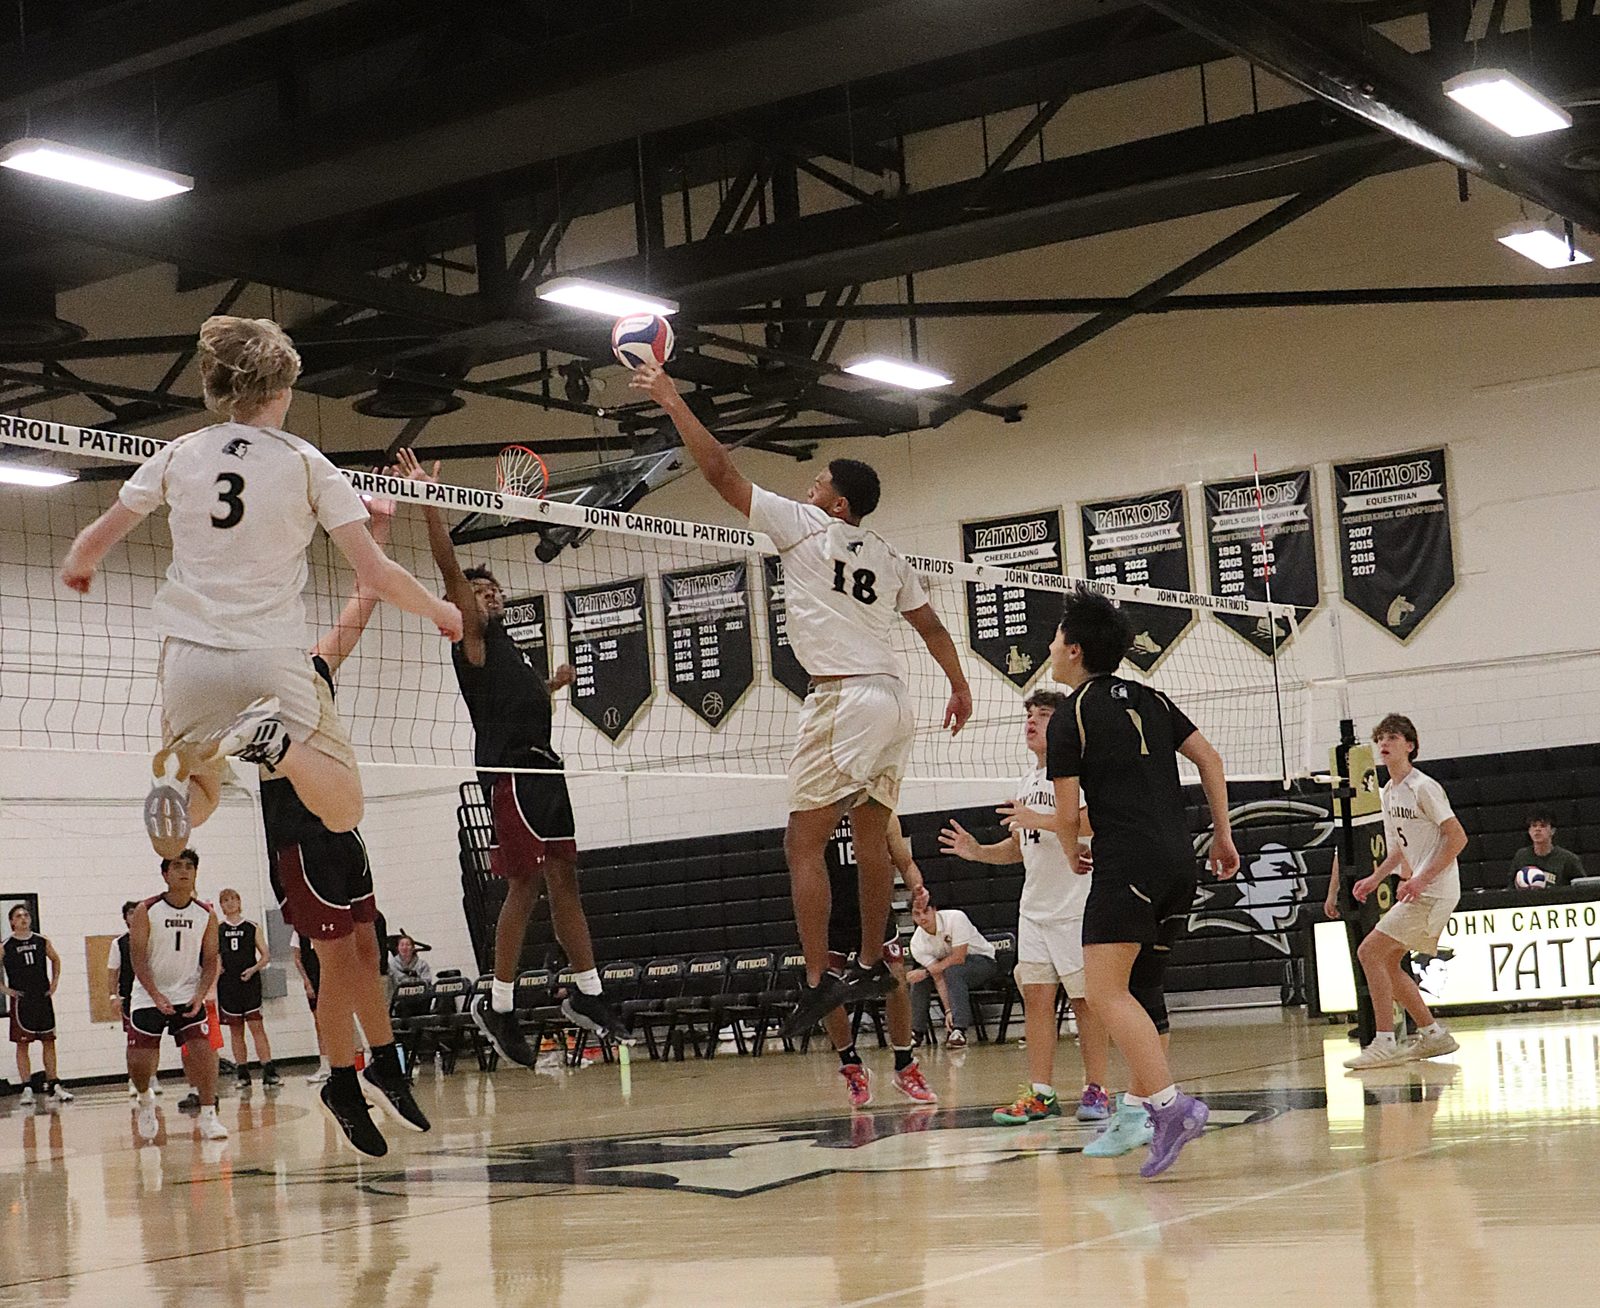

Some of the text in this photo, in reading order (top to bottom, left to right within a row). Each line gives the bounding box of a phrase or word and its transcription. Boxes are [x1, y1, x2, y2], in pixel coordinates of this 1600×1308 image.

[1348, 460, 1432, 492] PATRIOTS
[210, 472, 245, 529] 3
[426, 484, 504, 509] PATRIOTS
[1218, 480, 1298, 512] PATRIOTS
[1365, 492, 1417, 506] EQUESTRIAN
[1095, 499, 1172, 531] PATRIOTS
[1241, 515, 1264, 524] CROS
[584, 508, 755, 546] JOHN CARROLL PATRIOTS
[974, 519, 1048, 550] PATRIOTS
[1348, 526, 1373, 539] 2007
[1116, 533, 1138, 543] CROSS
[1140, 528, 1172, 539] COUNTRY
[1218, 545, 1242, 557] 1983
[1349, 539, 1374, 551] 2015
[984, 548, 1039, 563] CHEERLEADING
[1218, 557, 1243, 569] 2005
[1350, 552, 1375, 564] 2016
[1124, 559, 1148, 571] 2022
[1352, 564, 1376, 576] 2017
[673, 570, 736, 598] PATRIOTS
[831, 558, 878, 605] 18
[1004, 570, 1029, 585] JOHN
[1031, 573, 1072, 590] CARROLL
[1125, 571, 1150, 583] 2023
[1221, 582, 1245, 593] 2007
[575, 587, 637, 615] PATRIOTS
[976, 601, 1026, 616] 2004 2009
[1157, 591, 1177, 603] JOHN
[1179, 593, 1213, 608] CARROLL
[1215, 597, 1249, 612] PATRIOTS
[1004, 613, 1027, 624] 2010
[699, 624, 718, 635] 2011
[1005, 624, 1028, 636] 2023
[1512, 906, 1597, 932] CARRO
[175, 931, 182, 951] 1
[230, 937, 239, 951] 8
[24, 951, 35, 965] 11
